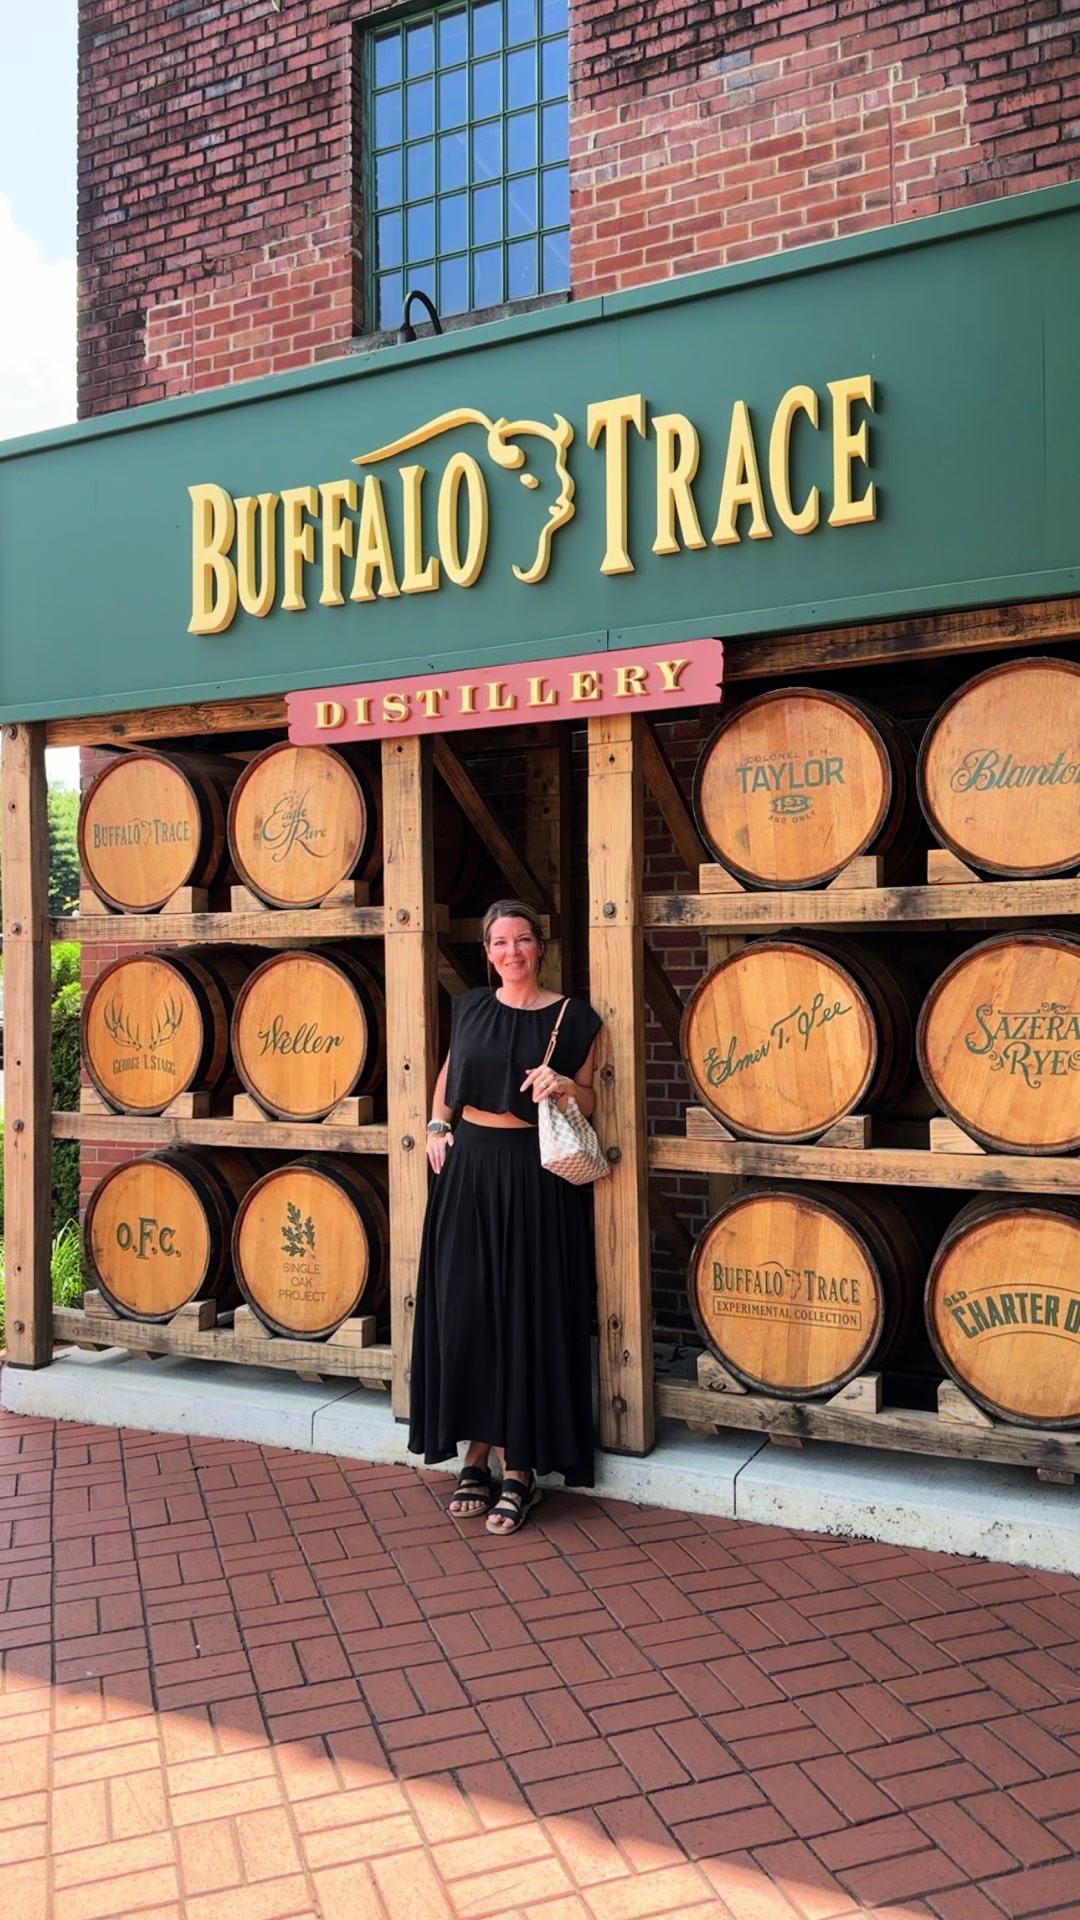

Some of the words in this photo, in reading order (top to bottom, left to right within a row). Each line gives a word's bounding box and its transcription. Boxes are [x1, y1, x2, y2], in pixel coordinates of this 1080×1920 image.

[187, 452, 488, 635] BUFFALO
[587, 375, 878, 575] TRACE
[314, 658, 692, 731] DISTILLERY
[736, 757, 845, 794] TAYLOR
[746, 752, 800, 764] COLONEL
[951, 749, 1080, 793] Blanto
[93, 823, 141, 849] BUFFALO
[153, 818, 191, 844] TRACE
[261, 785, 315, 850] Eagle
[768, 814, 787, 824] AND
[791, 810, 816, 824] ONLY
[271, 818, 337, 863] Rare
[257, 1014, 345, 1057] Weller
[703, 1036, 771, 1088] Elmer
[797, 992, 853, 1051] Lee
[964, 1003, 1080, 1055] SAZERA
[112, 1056, 140, 1075] GEORGE
[1002, 1041, 1070, 1089] RYE
[282, 1262, 321, 1275] SINGLE
[290, 1275, 313, 1288] OAK
[712, 1261, 785, 1297] BUFFALO
[804, 1269, 861, 1305] TRACE
[278, 1289, 327, 1302] PROJECT
[717, 1301, 791, 1319] EXPERIMENTAL
[794, 1309, 857, 1326] COLLECTION
[943, 1290, 968, 1307] OLD
[952, 1292, 1060, 1339] CHARTER
